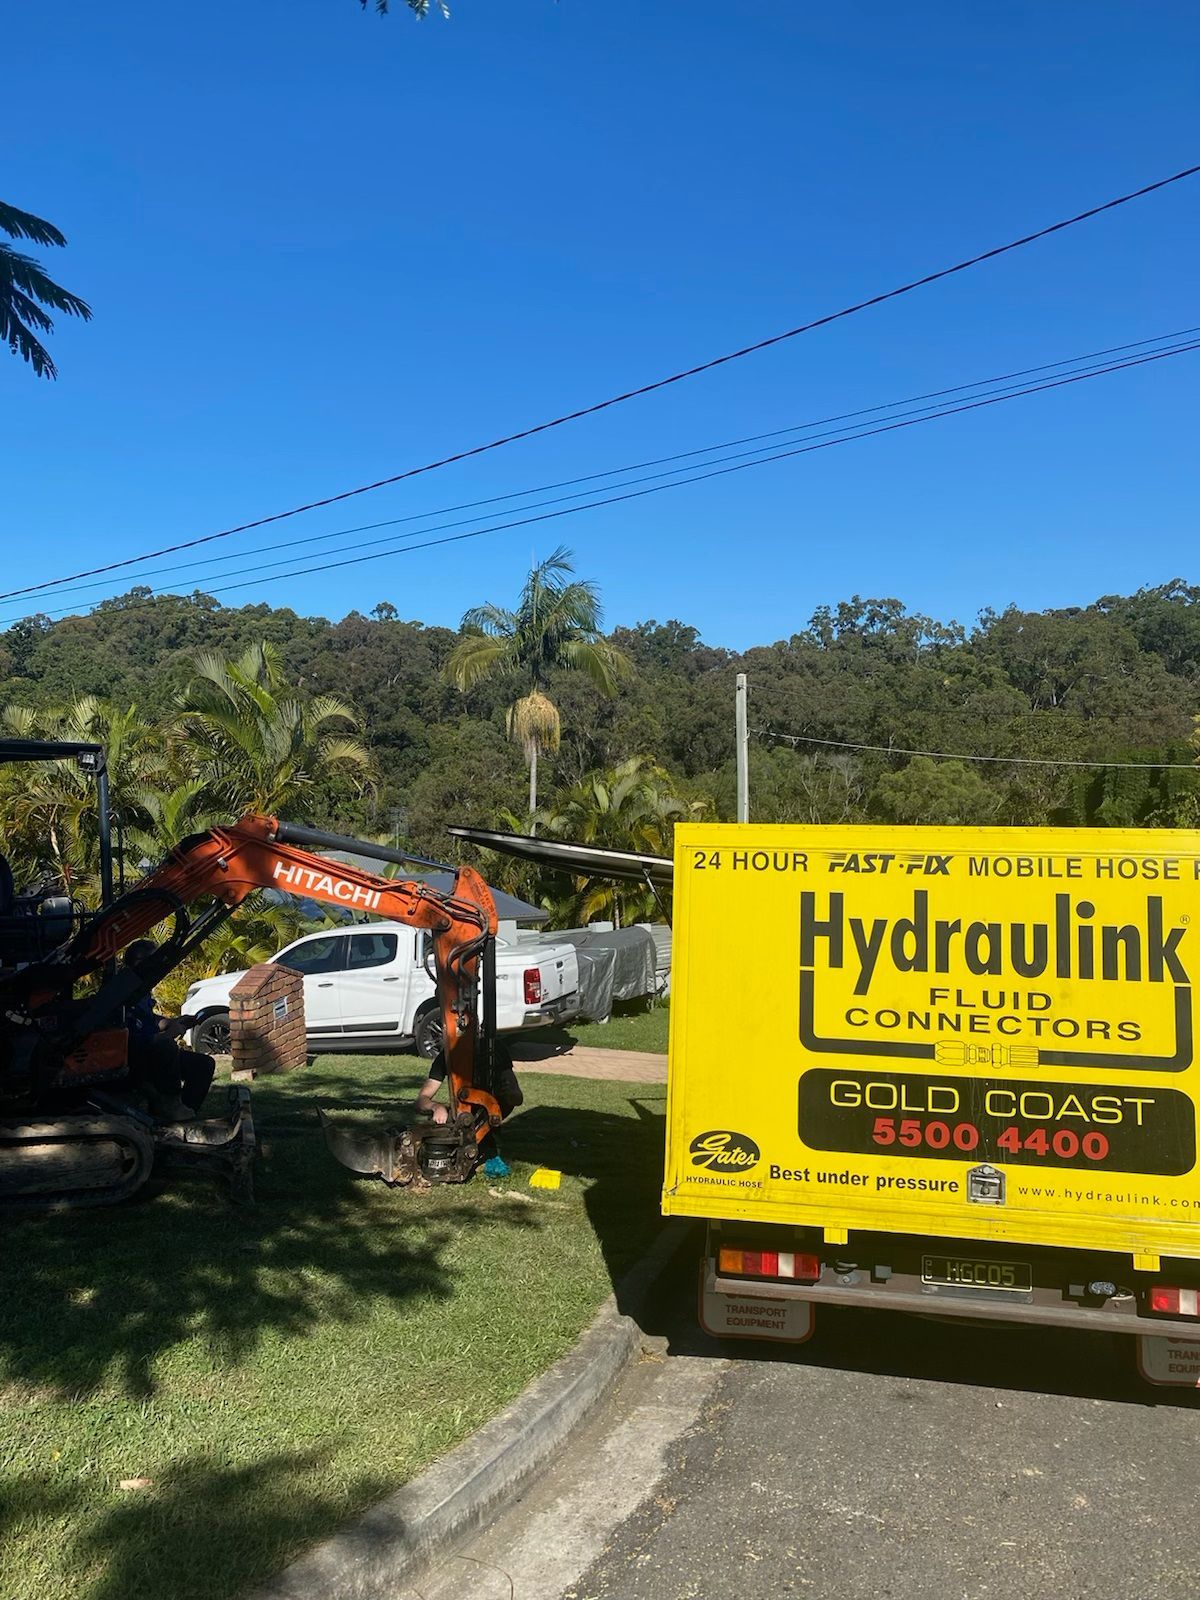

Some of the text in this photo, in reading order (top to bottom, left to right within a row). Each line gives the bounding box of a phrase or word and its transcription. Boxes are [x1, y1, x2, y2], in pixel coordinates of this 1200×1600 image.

[692, 850, 722, 870] 24
[732, 850, 808, 872] HOUR
[968, 856, 1083, 878] MOBILE
[1095, 858, 1180, 880] HOSE
[272, 861, 382, 909] HITACHI
[800, 890, 1191, 996] Hydraulink
[929, 987, 1052, 1011] FLUID
[845, 1007, 1142, 1041] CONNECTORS
[829, 1080, 1155, 1126] GOLD COAST
[691, 1133, 759, 1167] Gates
[872, 1117, 1109, 1161] 5500 4400
[686, 1175, 763, 1189] HYDRAULIC HOSE
[769, 1164, 959, 1194] Best under pressure
[725, 1304, 787, 1318] TRANSPORT
[726, 1317, 786, 1330] EQUIPMENT
